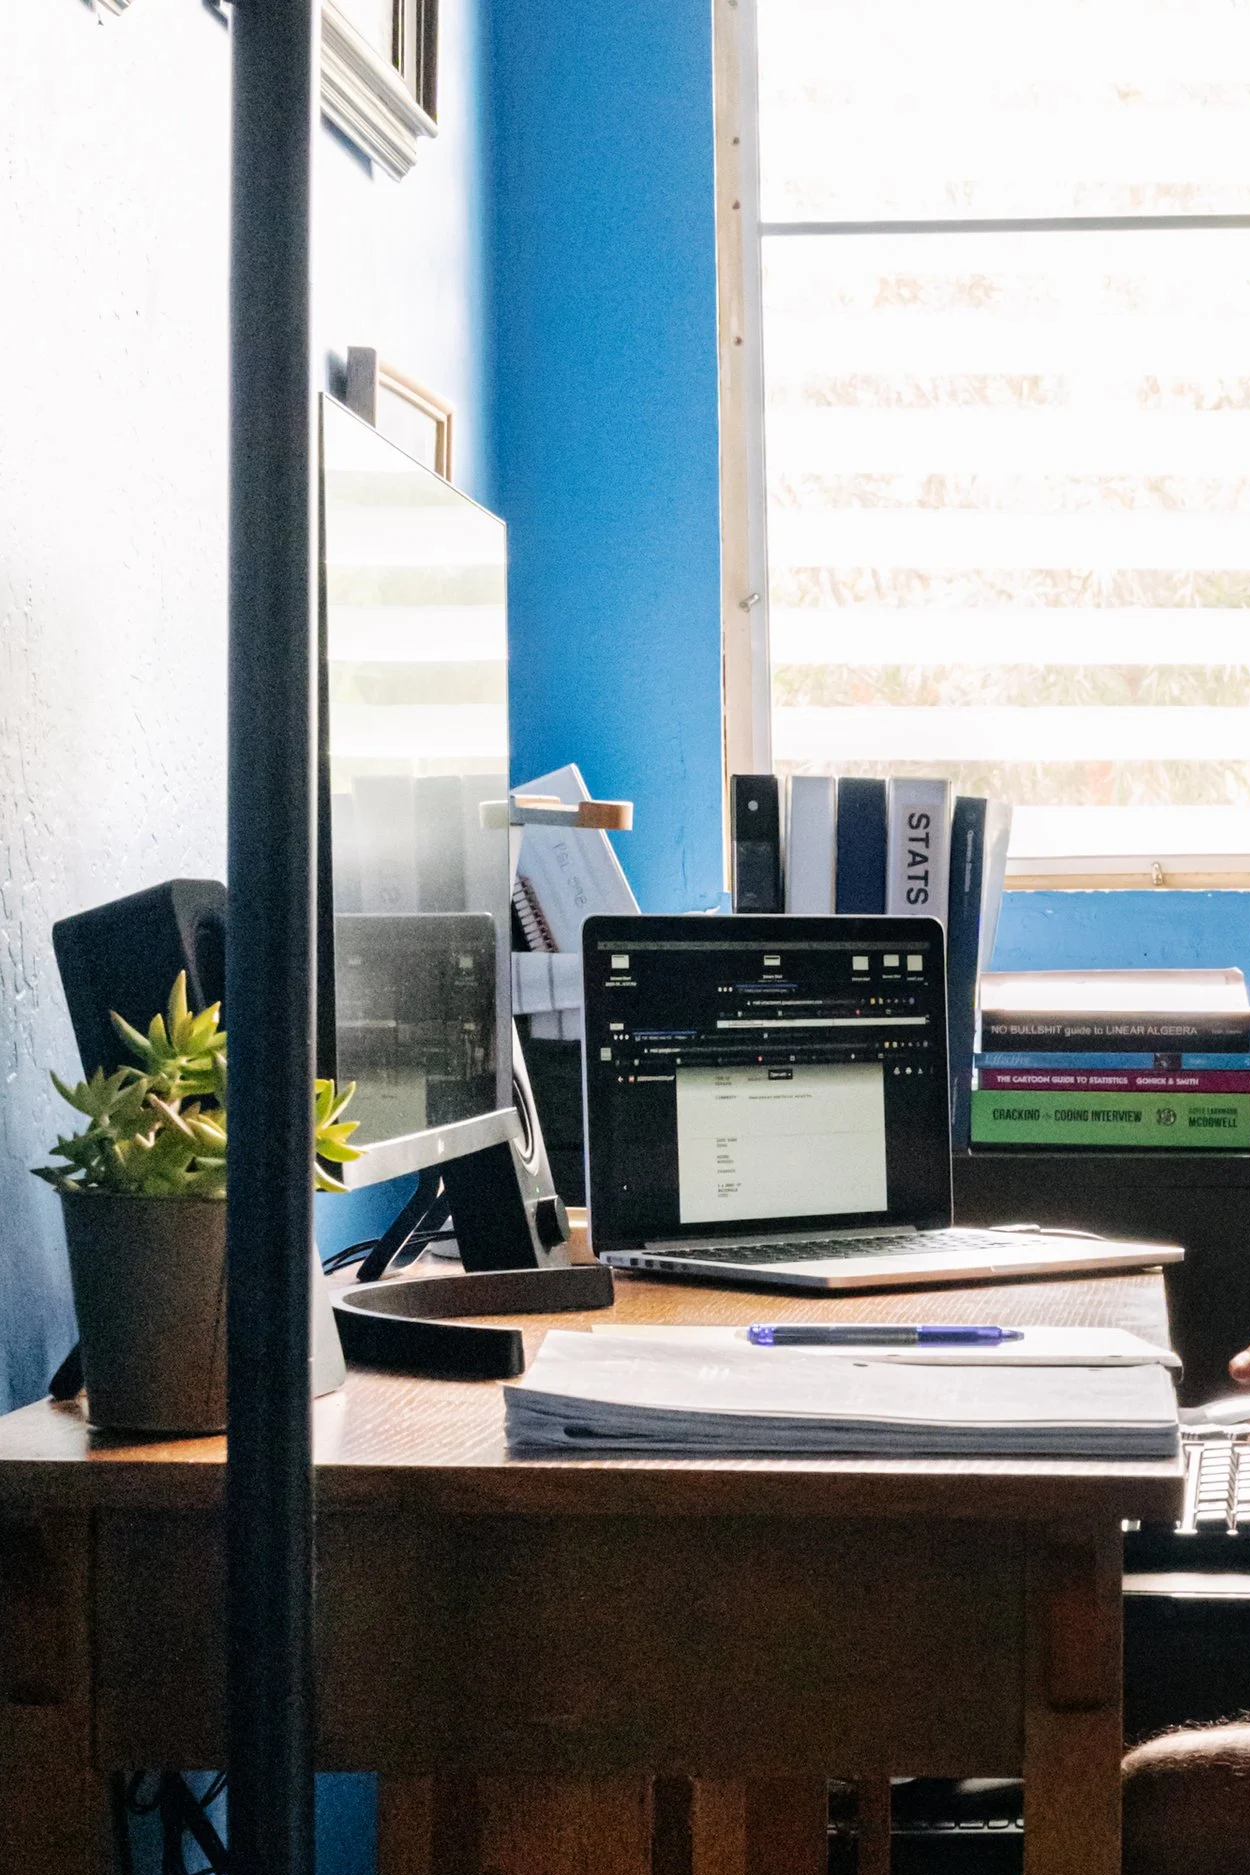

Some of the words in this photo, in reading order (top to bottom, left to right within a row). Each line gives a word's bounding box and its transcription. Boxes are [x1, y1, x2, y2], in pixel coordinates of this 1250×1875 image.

[906, 812, 931, 905] STATS
[990, 1025, 1008, 1035] NO
[1010, 1025, 1063, 1035] BULLSHIT
[1064, 1025, 1092, 1037] guide
[1094, 1026, 1103, 1035] to
[1106, 1025, 1145, 1036] LINEAR
[1147, 1026, 1198, 1036] ALGEBRA
[996, 1075, 1011, 1083] THE
[1012, 1075, 1050, 1084] CARTOON
[1051, 1076, 1075, 1084] GUIDE
[1076, 1076, 1088, 1084] TO
[1089, 1076, 1129, 1085] STATISTICS
[1136, 1077, 1167, 1086] GONICK
[1168, 1077, 1174, 1086] &
[1176, 1078, 1199, 1086] SMITH
[992, 1108, 1041, 1121] CRACKING
[1054, 1109, 1089, 1122] CODING
[1091, 1109, 1142, 1123] INTERVIEW
